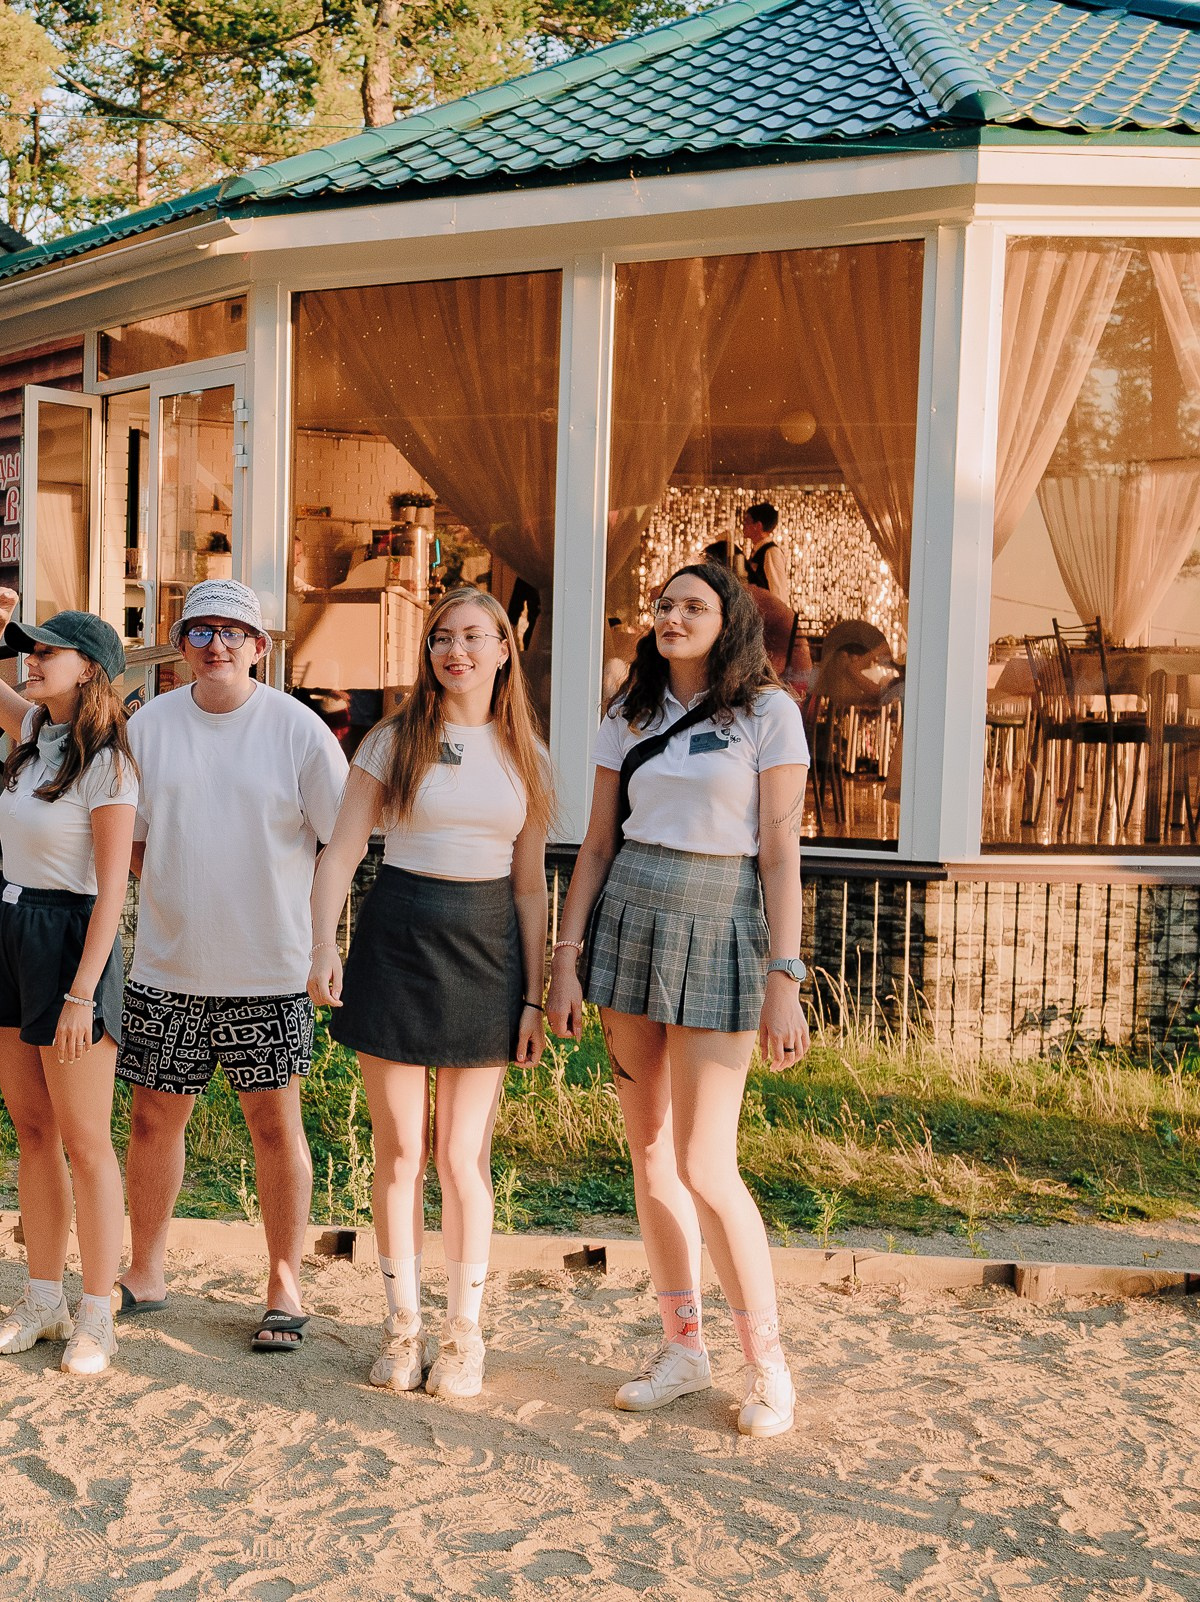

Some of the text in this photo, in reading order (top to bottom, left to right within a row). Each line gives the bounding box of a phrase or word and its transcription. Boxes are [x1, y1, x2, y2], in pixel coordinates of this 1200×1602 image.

[211, 1004, 278, 1022] Kappa
[160, 1011, 186, 1069] Kappa
[211, 1020, 283, 1047] Kap
[176, 1049, 210, 1060] ppa
[275, 1047, 288, 1089] Kap
